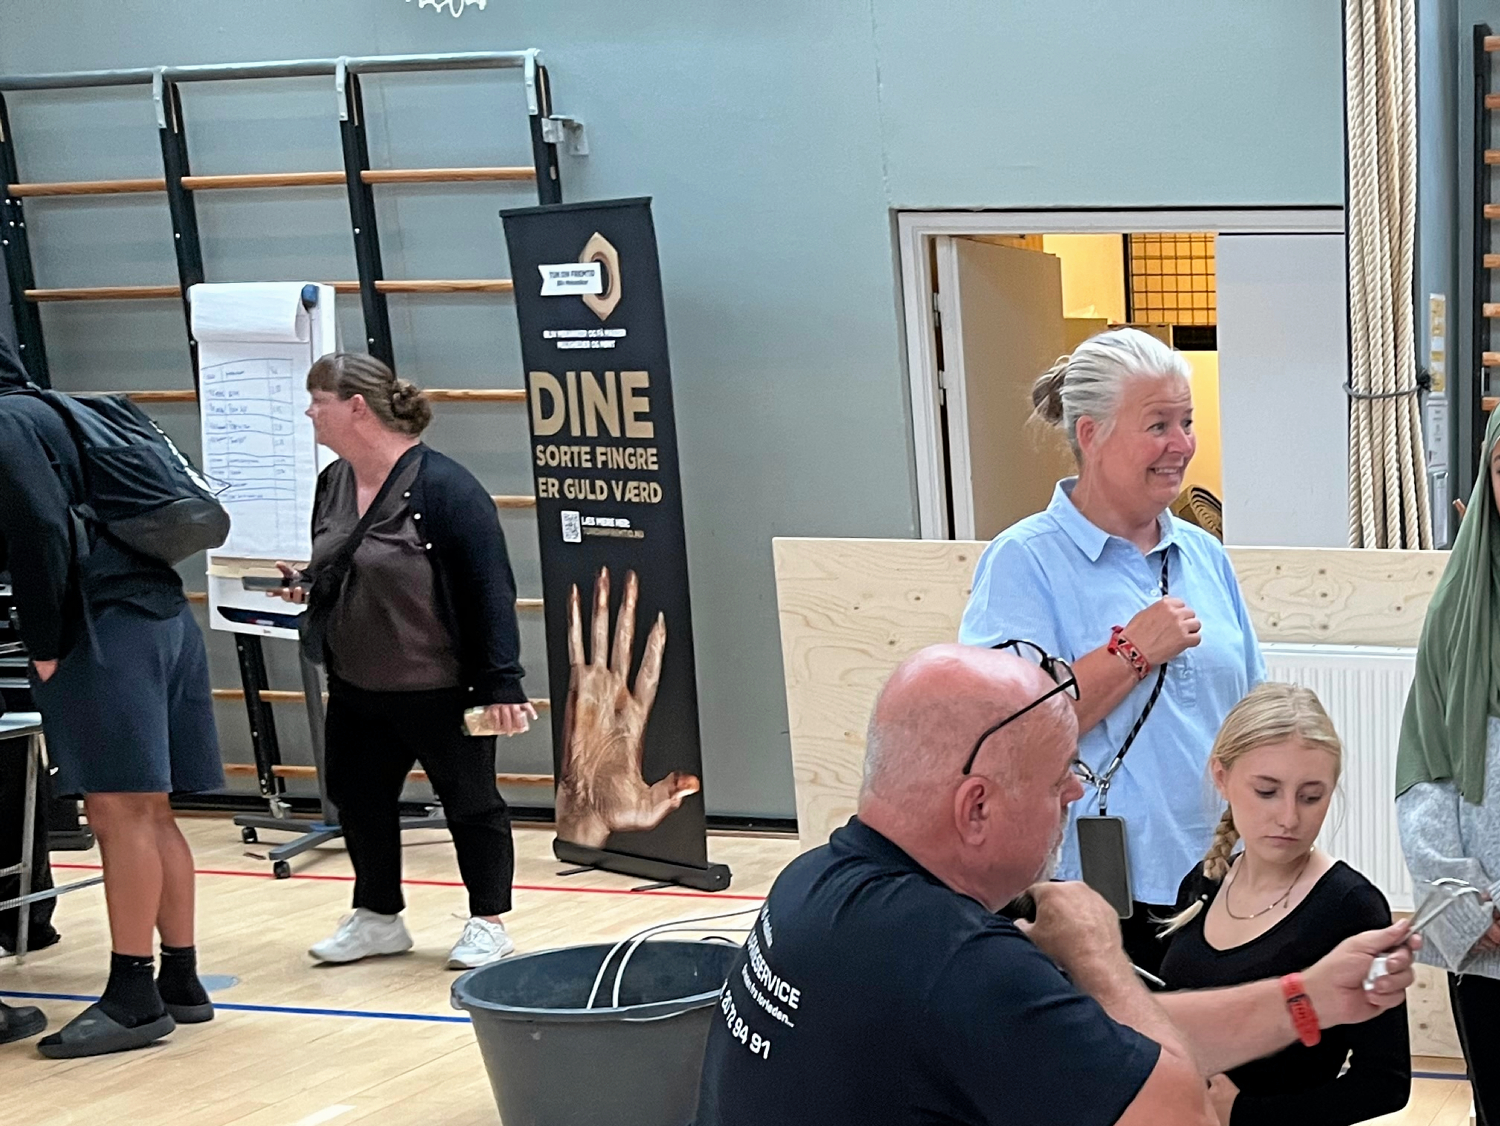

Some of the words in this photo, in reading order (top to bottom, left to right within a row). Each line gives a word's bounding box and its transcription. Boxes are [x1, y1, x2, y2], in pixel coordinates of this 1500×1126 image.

[529, 370, 655, 439] DINE
[535, 444, 592, 468] SORTE
[595, 446, 659, 470] FINGRE
[538, 477, 560, 498] ER
[563, 478, 608, 501] GULD
[610, 480, 663, 503] VÆRD
[732, 1016, 749, 1045] 94
[749, 1032, 771, 1060] 91
